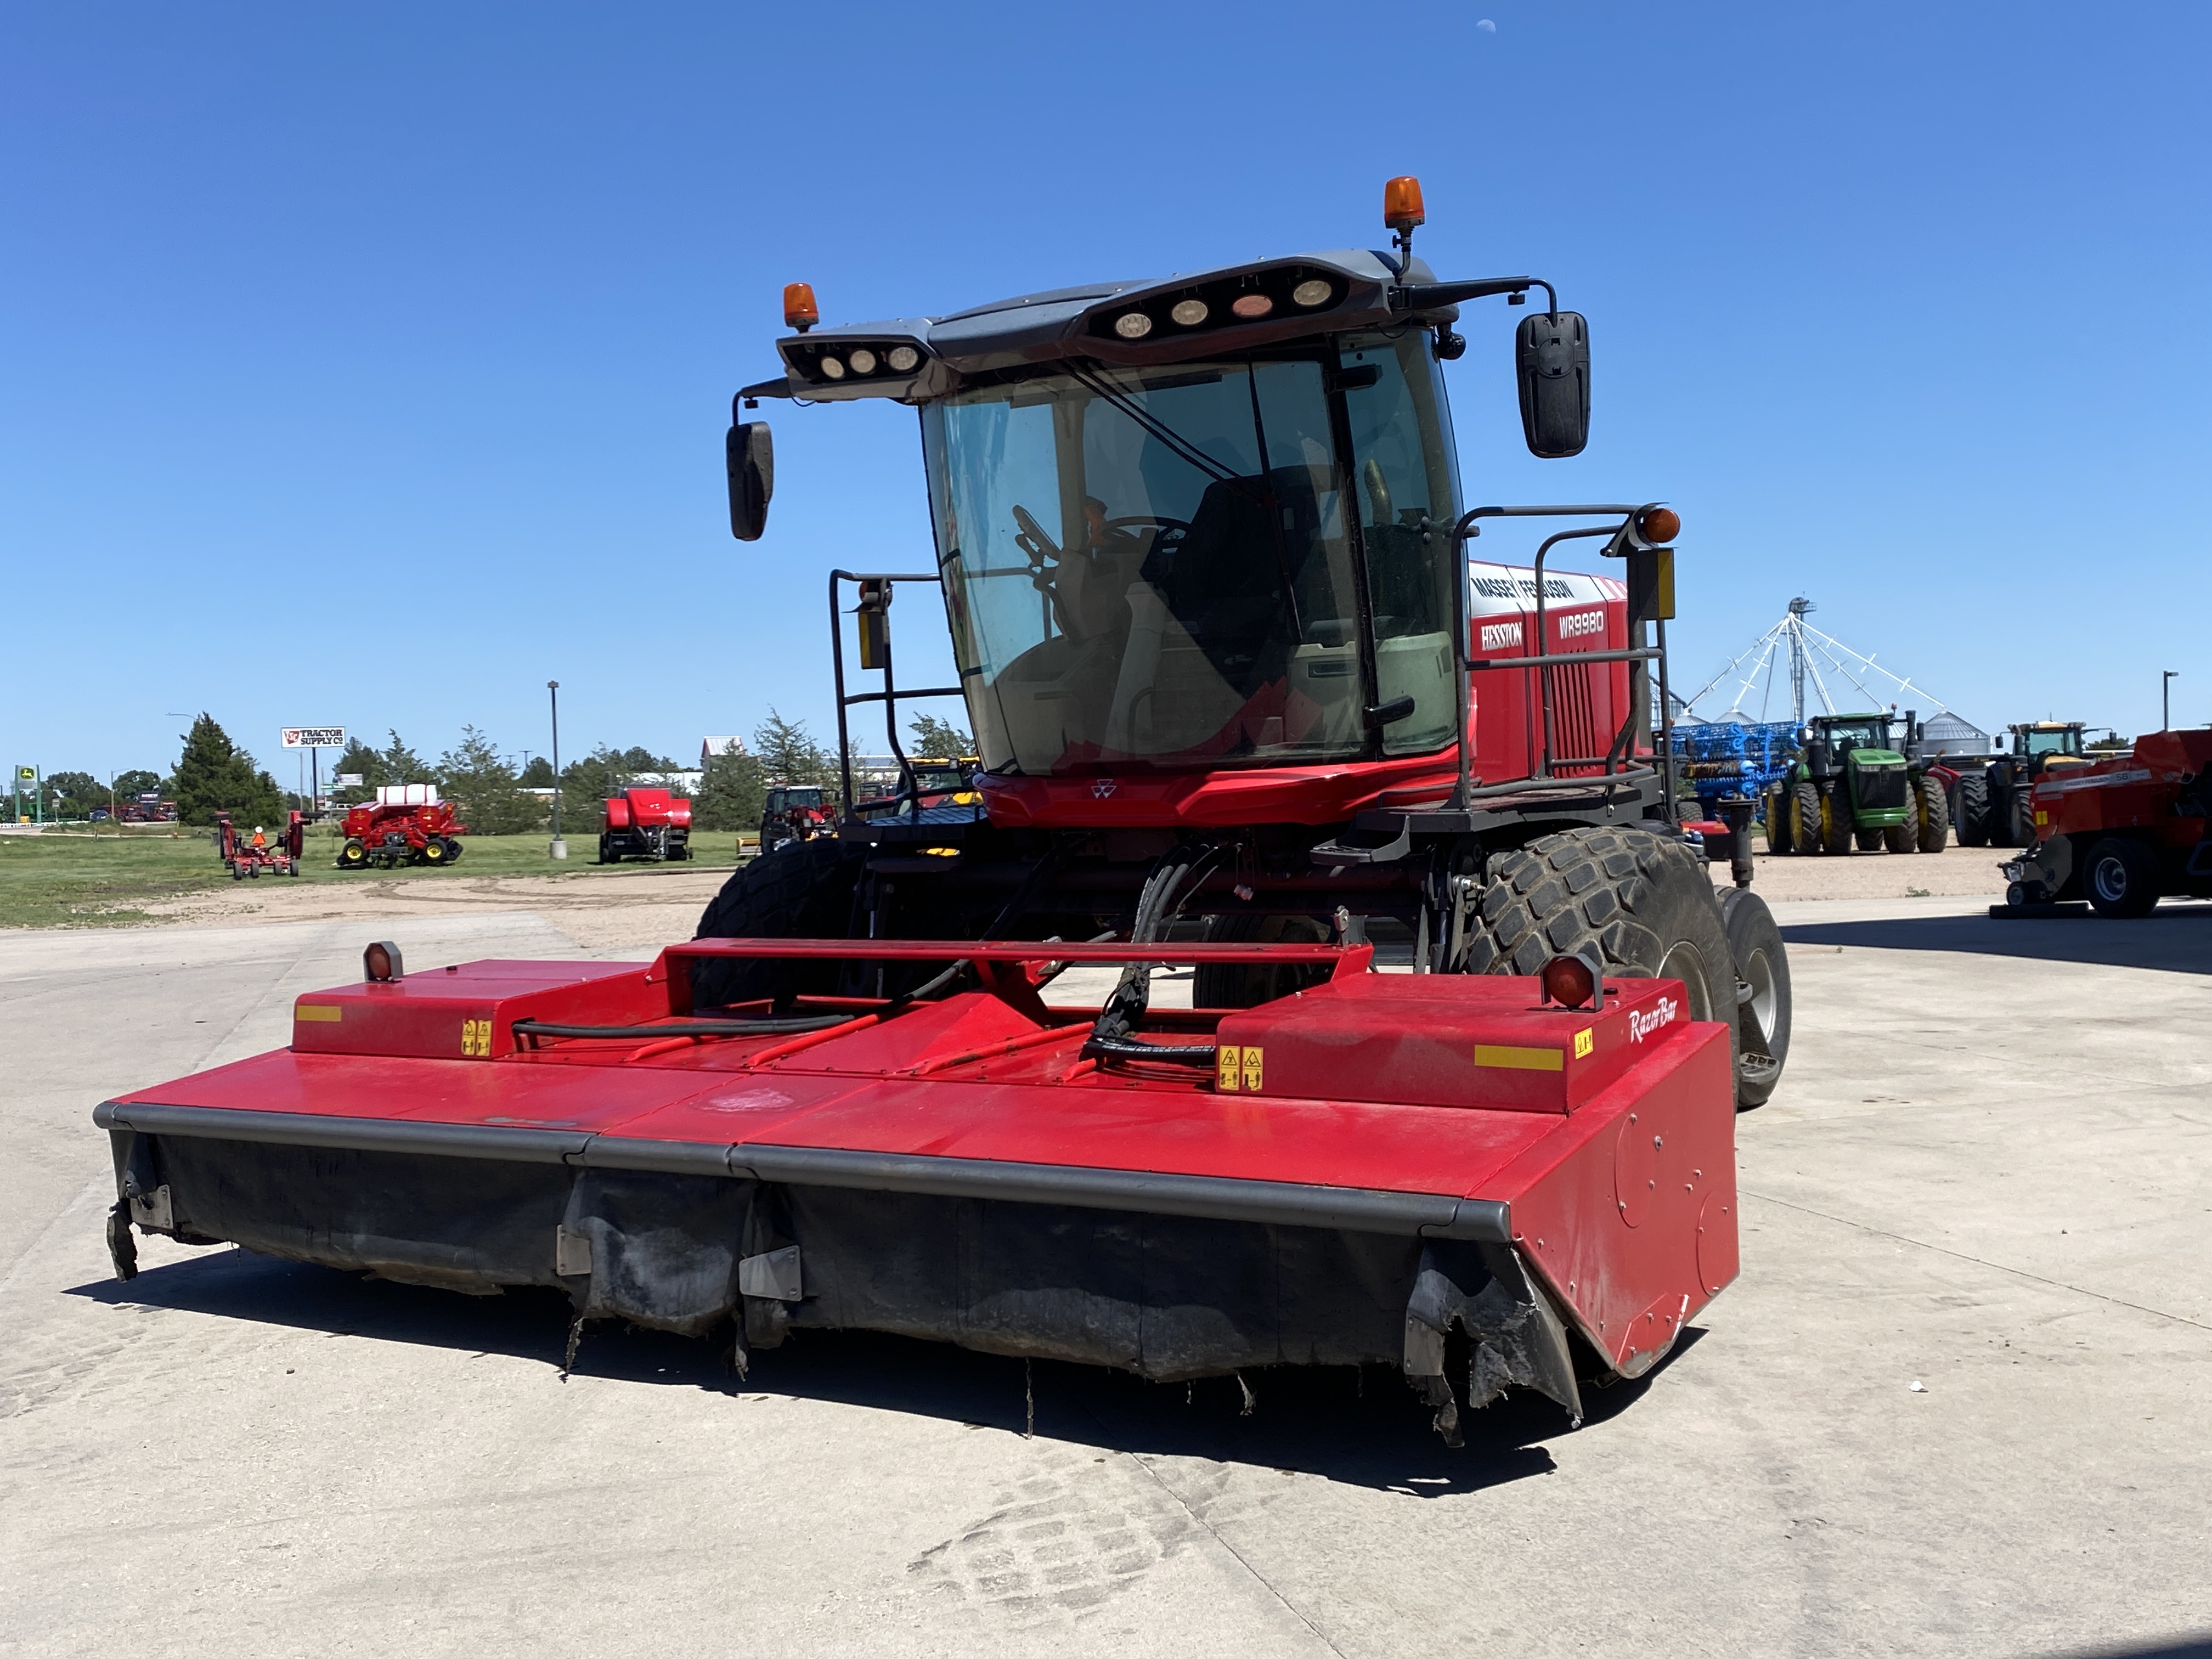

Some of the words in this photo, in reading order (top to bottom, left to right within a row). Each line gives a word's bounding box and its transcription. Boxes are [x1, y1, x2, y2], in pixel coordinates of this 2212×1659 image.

[1470, 577, 1521, 599] MASSEY
[1481, 621, 1522, 651] HESSTON
[1559, 611, 1604, 640] WR9980
[285, 731, 298, 742] TSC
